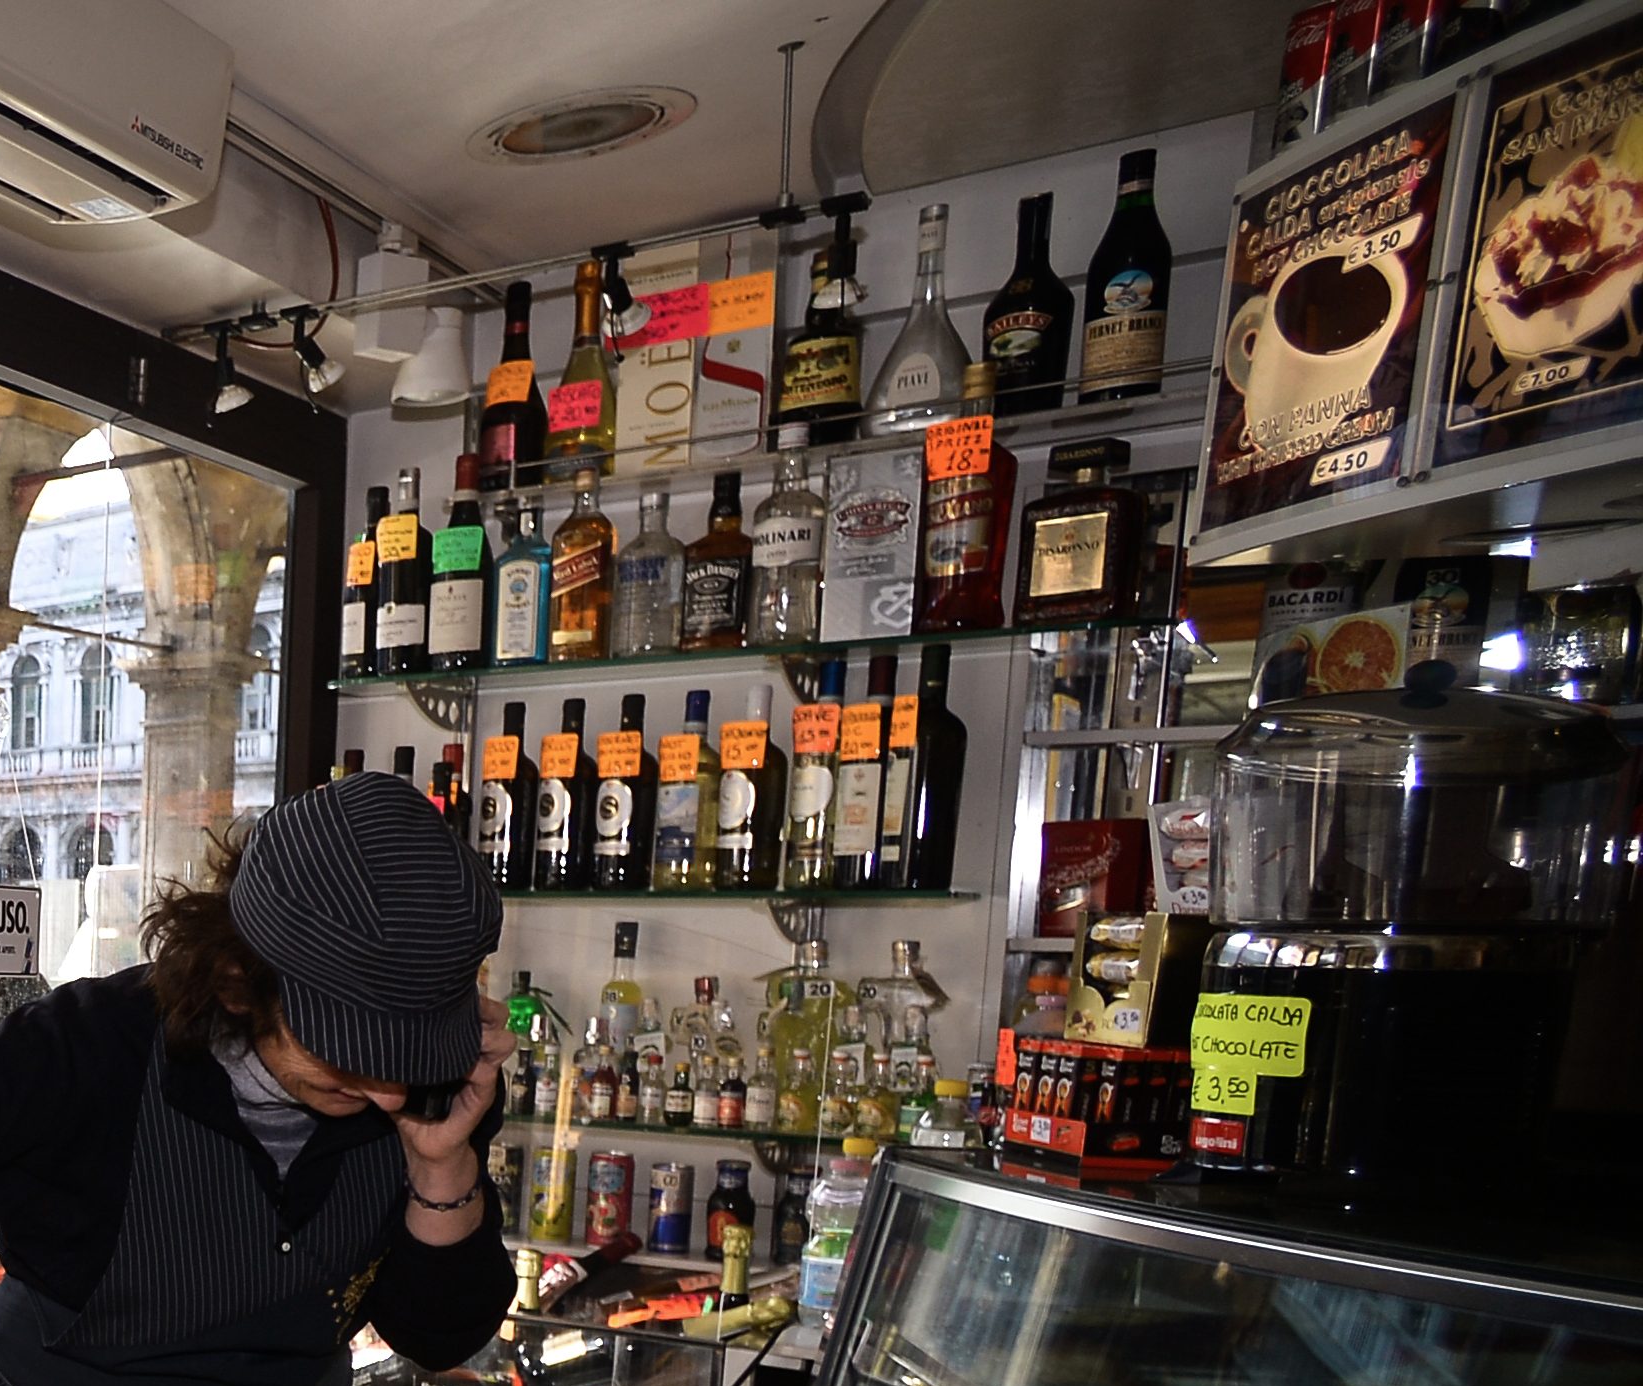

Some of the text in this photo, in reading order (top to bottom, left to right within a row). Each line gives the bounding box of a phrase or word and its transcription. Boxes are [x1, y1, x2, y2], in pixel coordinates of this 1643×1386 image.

[1501, 122, 1564, 165] SAN
[1266, 130, 1411, 223] CIOCCOLATA
[1247, 207, 1311, 259] CALDA
[1252, 190, 1412, 285] HOT CHOCOLATE
[1238, 384, 1372, 450] CON PANNA
[1325, 406, 1396, 449] CREAM
[809, 983, 832, 997] 20
[1245, 1004, 1303, 1026] CALDA
[1201, 1035, 1300, 1060] CHOCOLATE
[1195, 1135, 1238, 1150] ugolini
